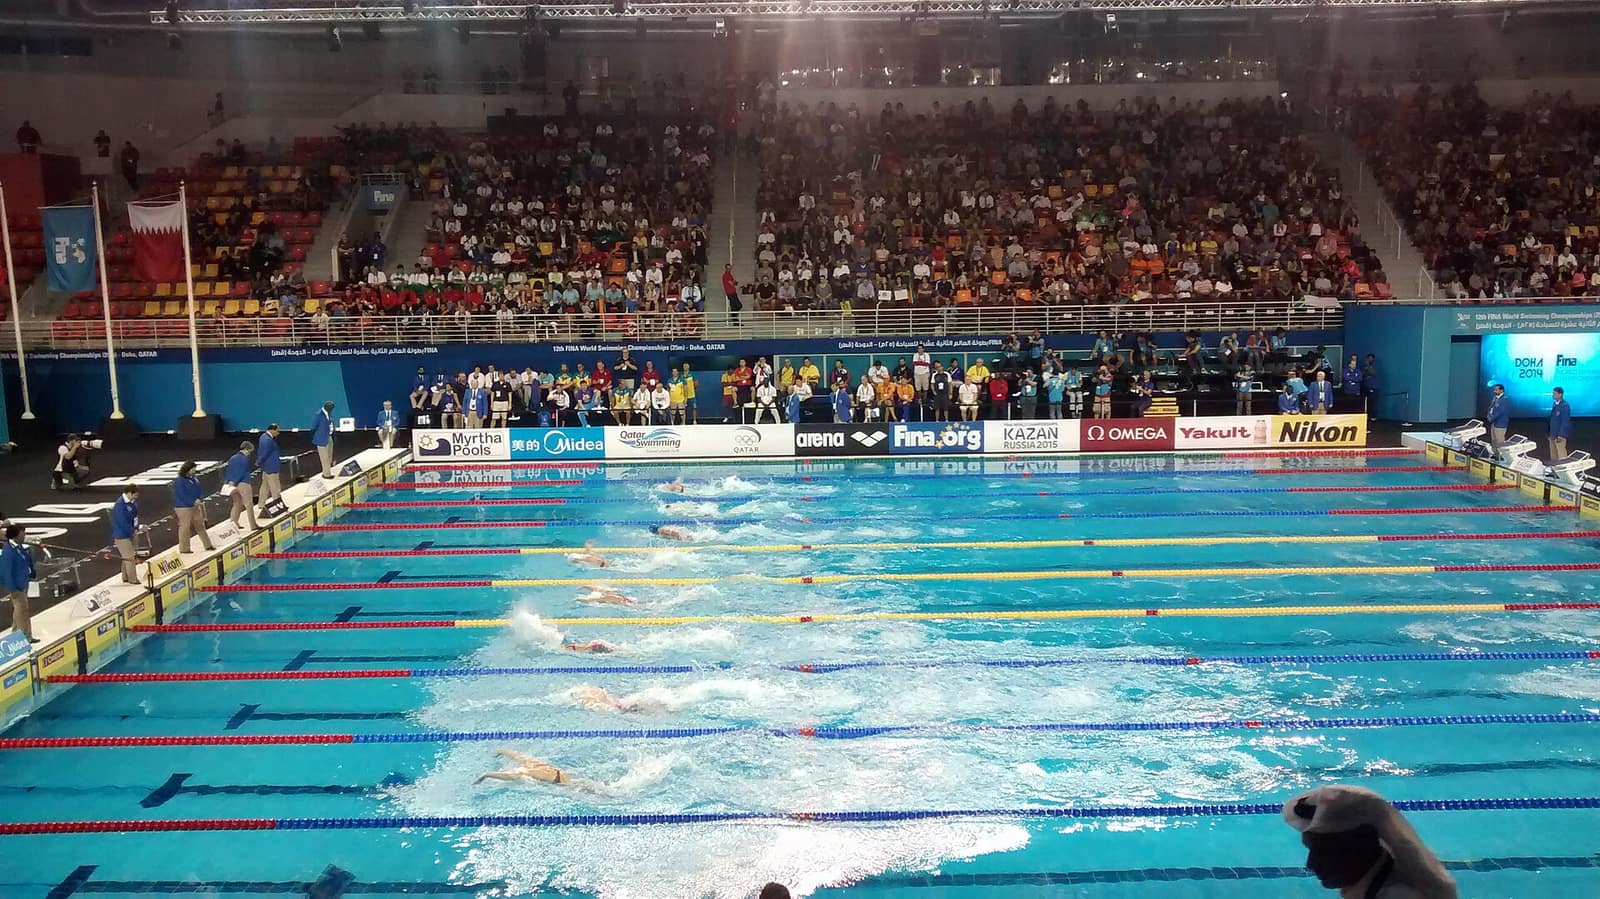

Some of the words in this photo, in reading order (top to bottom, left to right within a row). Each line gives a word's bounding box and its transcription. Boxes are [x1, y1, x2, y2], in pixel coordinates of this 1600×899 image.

[1515, 358, 1543, 367] DOHA
[1556, 354, 1577, 367] Fina
[1519, 369, 1543, 378] 2014
[620, 430, 646, 440] Qatar
[1004, 427, 1058, 440] KAZAN
[1109, 427, 1168, 441] OMEGA
[1180, 427, 1251, 439] Yakult
[1279, 422, 1358, 443] Nikon
[452, 432, 502, 446] Myrtha
[553, 438, 604, 452] Midea
[636, 437, 681, 449] Swimming
[796, 432, 845, 448] arena
[1003, 441, 1036, 449] RUSSIA
[1036, 441, 1058, 449] 2015
[453, 444, 491, 456] Pools
[511, 440, 540, 451] 美的
[733, 446, 760, 454] QATAR
[157, 557, 182, 576] Nikon
